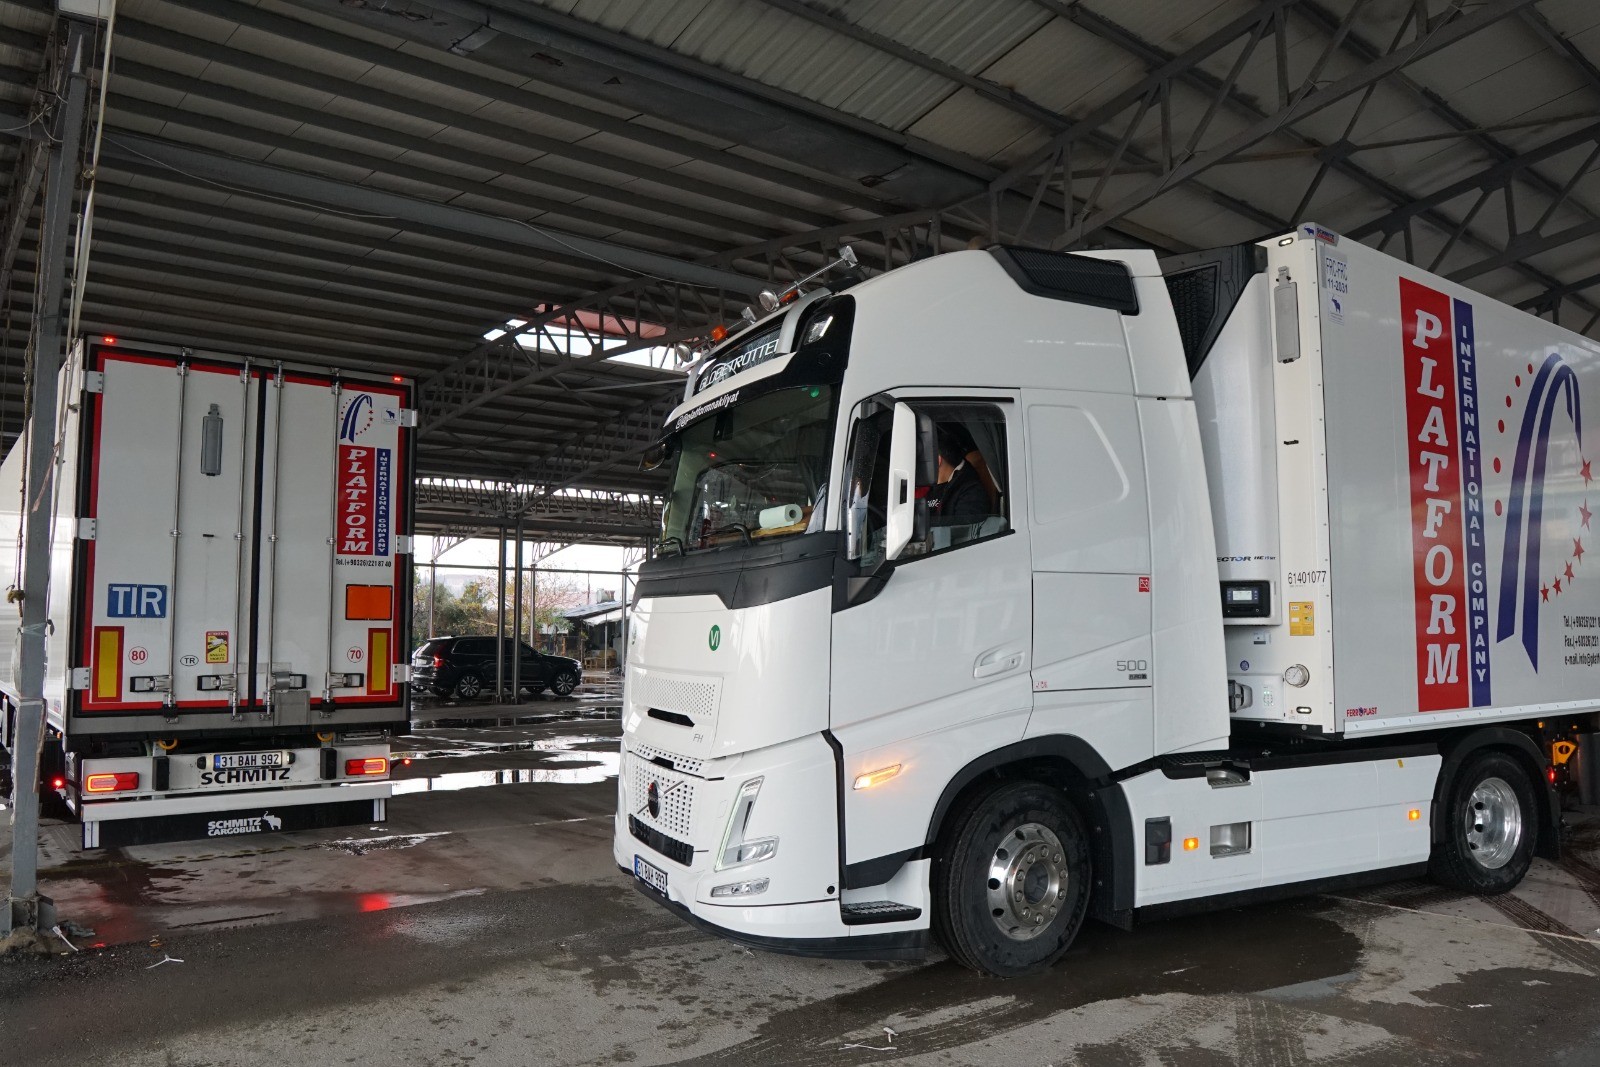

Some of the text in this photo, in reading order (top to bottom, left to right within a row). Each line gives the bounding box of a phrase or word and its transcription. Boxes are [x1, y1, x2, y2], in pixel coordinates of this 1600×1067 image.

[342, 449, 369, 552] PLATFORM
[377, 452, 388, 553] INTERNATIONAL COMPANY
[1412, 308, 1461, 685] PLATFORM
[1460, 325, 1487, 682] INTERNATIONAL COMPANY
[1287, 571, 1327, 585] 61401077
[112, 586, 163, 615] TIR
[131, 650, 145, 661] 80
[350, 650, 362, 660] 70
[1116, 659, 1147, 672] 500
[221, 753, 279, 768] 31 BAH 992
[200, 768, 291, 785] SCHMITZ
[207, 817, 262, 830] SCHMITZ
[207, 825, 262, 836] CARGOBULL
